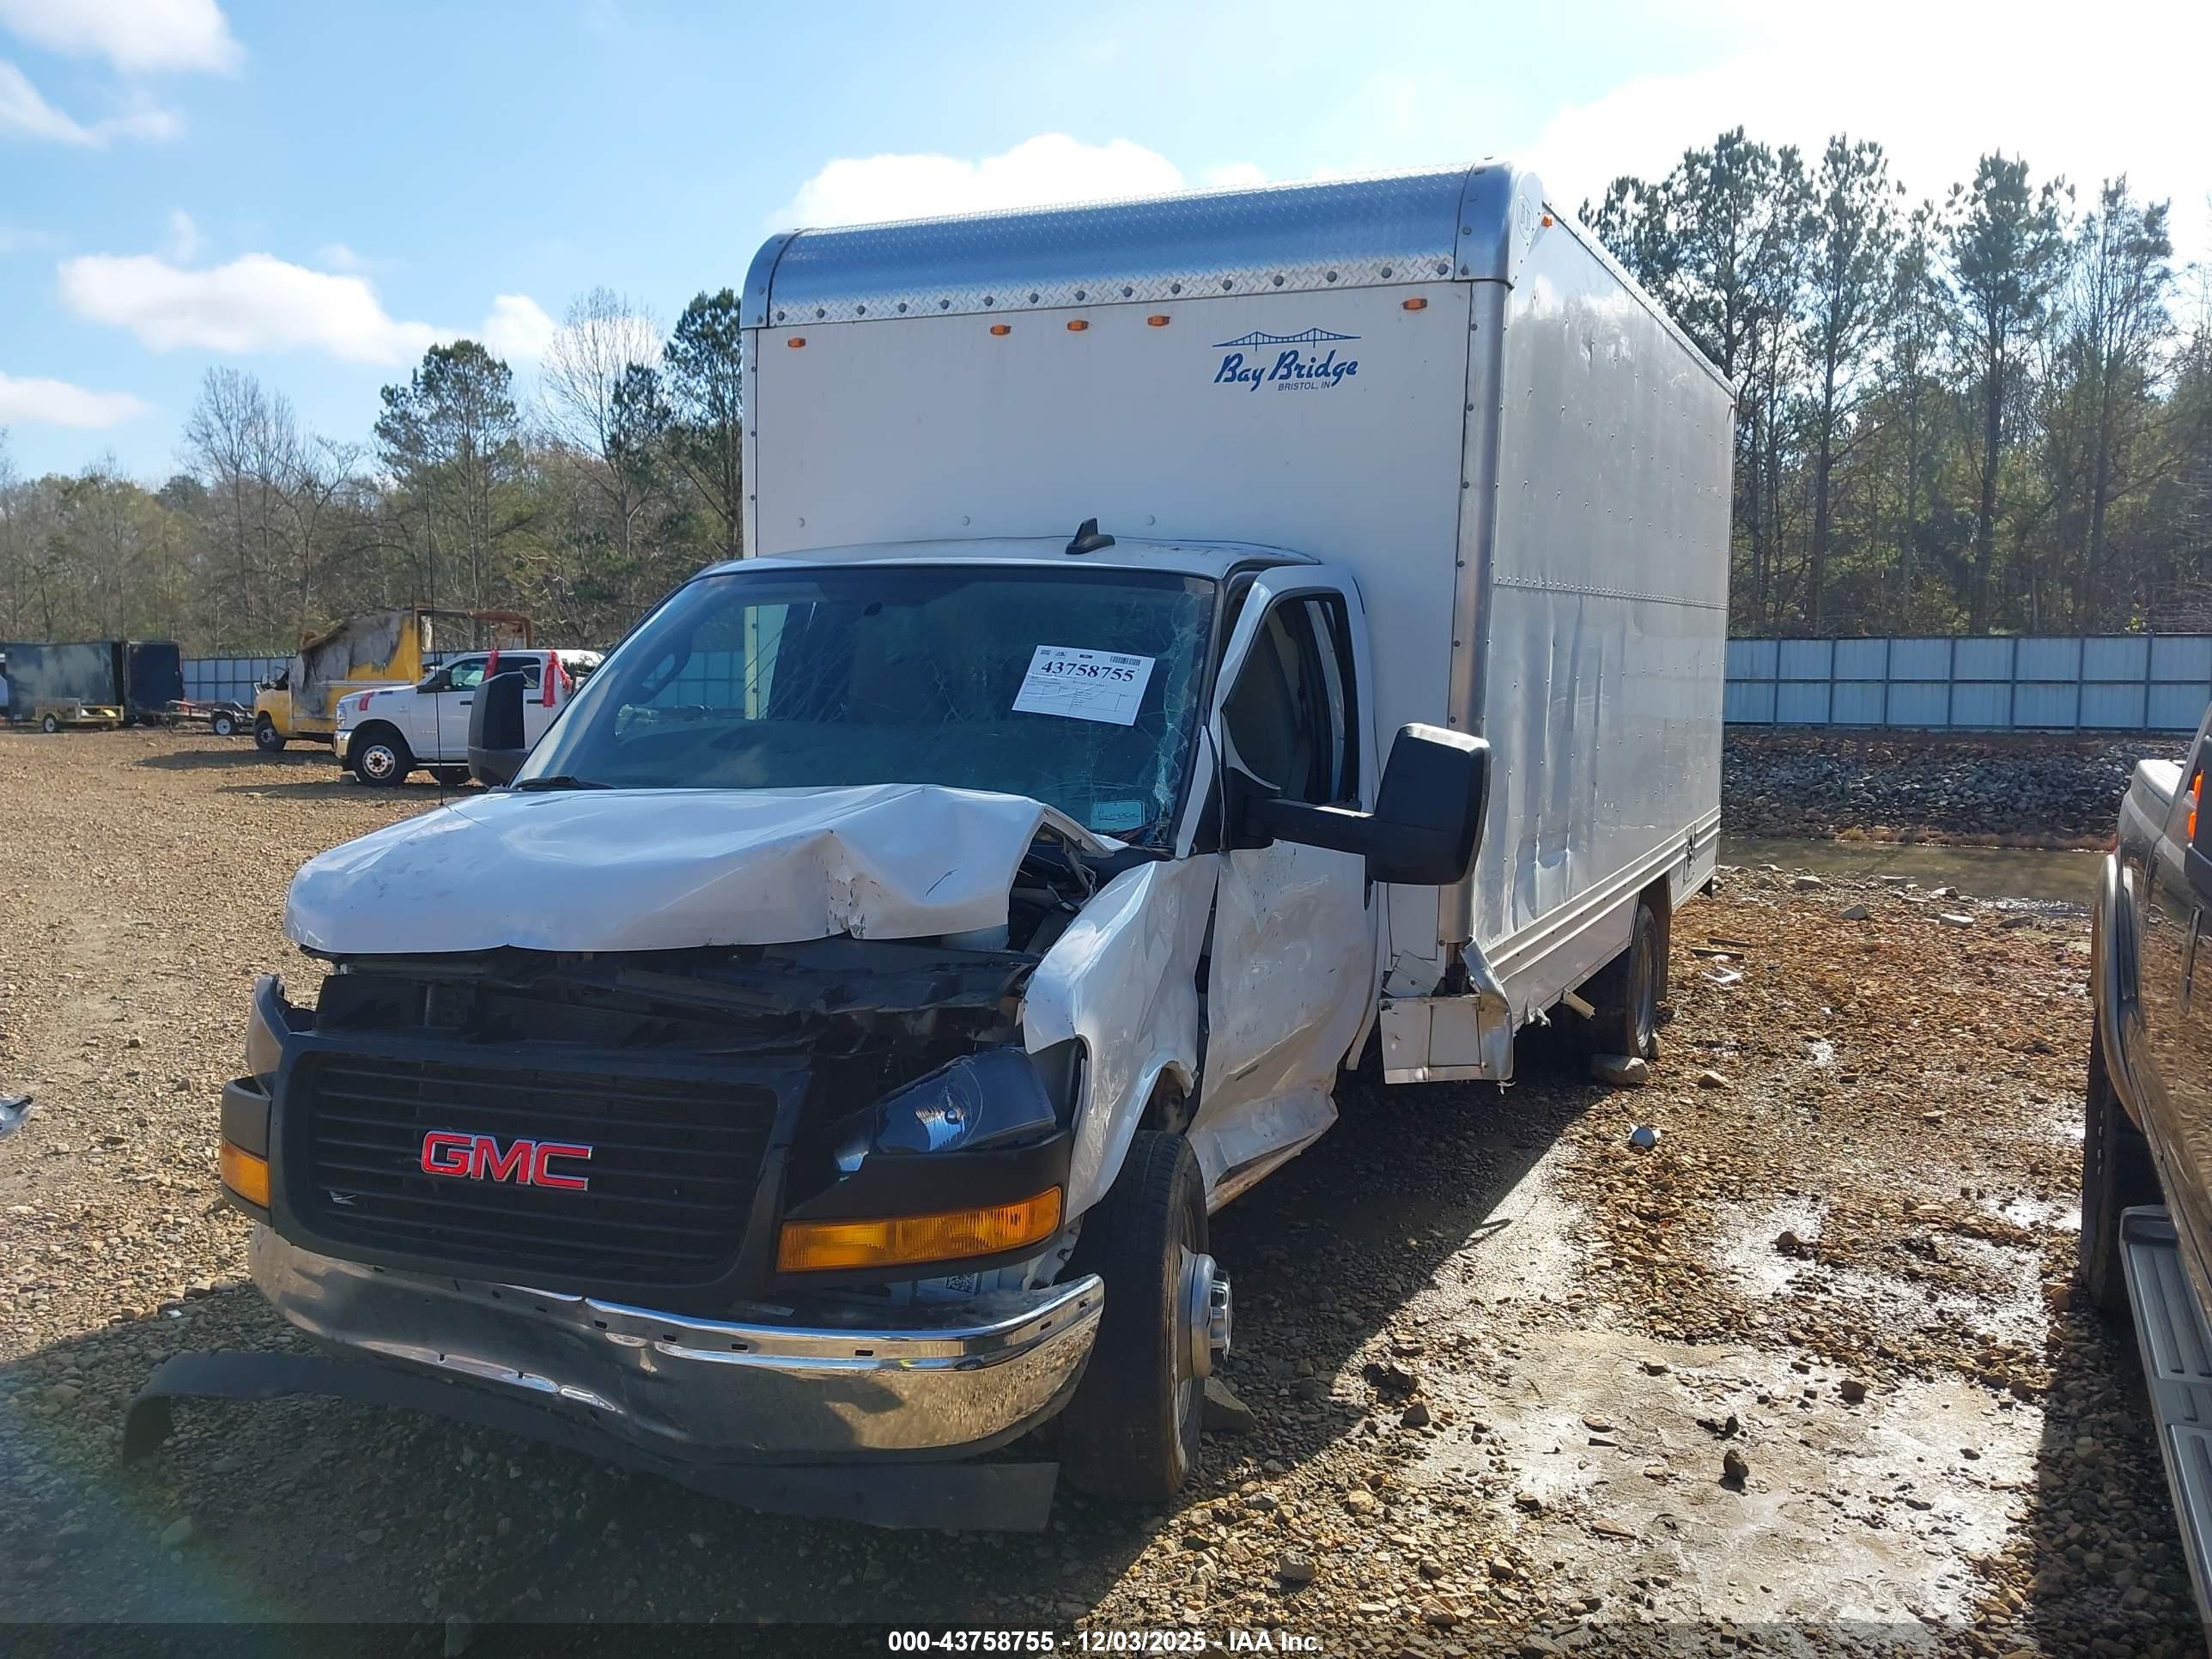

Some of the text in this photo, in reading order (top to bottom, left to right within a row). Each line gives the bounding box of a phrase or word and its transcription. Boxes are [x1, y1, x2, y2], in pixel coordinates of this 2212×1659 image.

[1213, 348, 1359, 392] Bay Bridge
[1277, 380, 1331, 392] BRISTOL, IN
[1041, 660, 1136, 683] 43758755
[420, 1130, 593, 1192] GMC
